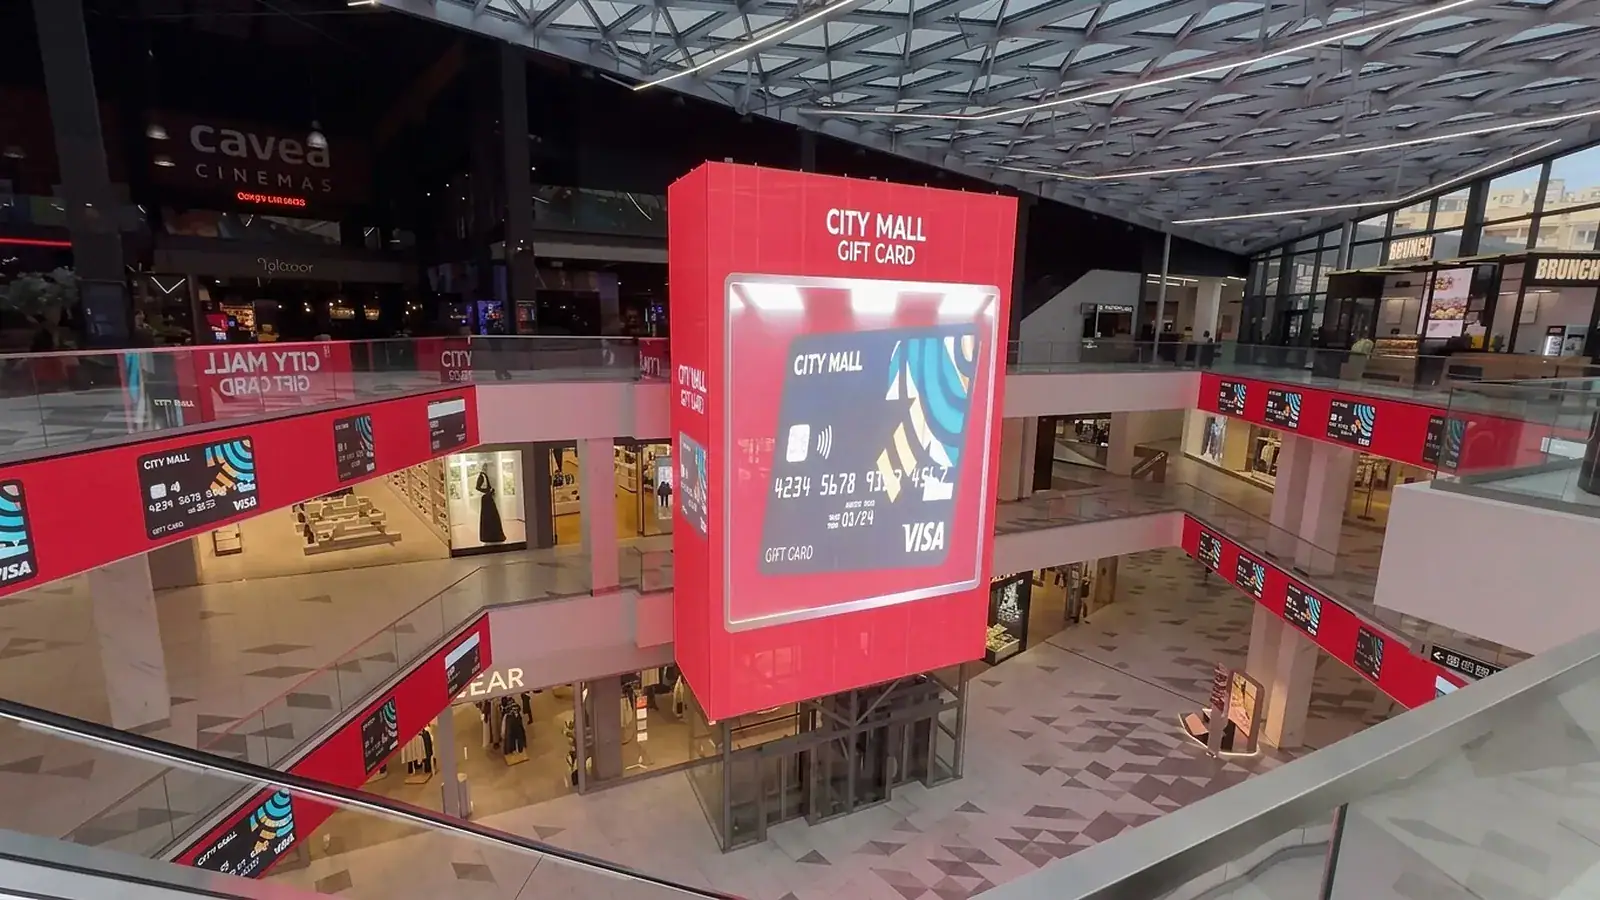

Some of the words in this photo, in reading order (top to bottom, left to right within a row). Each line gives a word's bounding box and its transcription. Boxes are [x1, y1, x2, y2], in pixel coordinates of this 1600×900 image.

[189, 124, 331, 168] cavea
[195, 164, 332, 193] CINEMAS
[826, 208, 871, 237] CITY
[876, 212, 926, 242] MALL
[837, 240, 871, 264] GIFT
[875, 243, 916, 266] CARD
[1389, 236, 1433, 260] BRUNCH
[1534, 258, 1600, 280] BRUNCH
[794, 353, 826, 376] CITY
[828, 350, 863, 373] MALL
[143, 458, 165, 470] CITY
[166, 453, 191, 466] MALL
[774, 472, 811, 499] 4234
[233, 496, 257, 511] VISA
[841, 510, 875, 527] 03/24
[902, 521, 944, 552] VISA
[765, 548, 786, 563] GIFT
[788, 545, 813, 560] CARD
[0, 560, 32, 581] ISA
[456, 667, 525, 699] EAR
